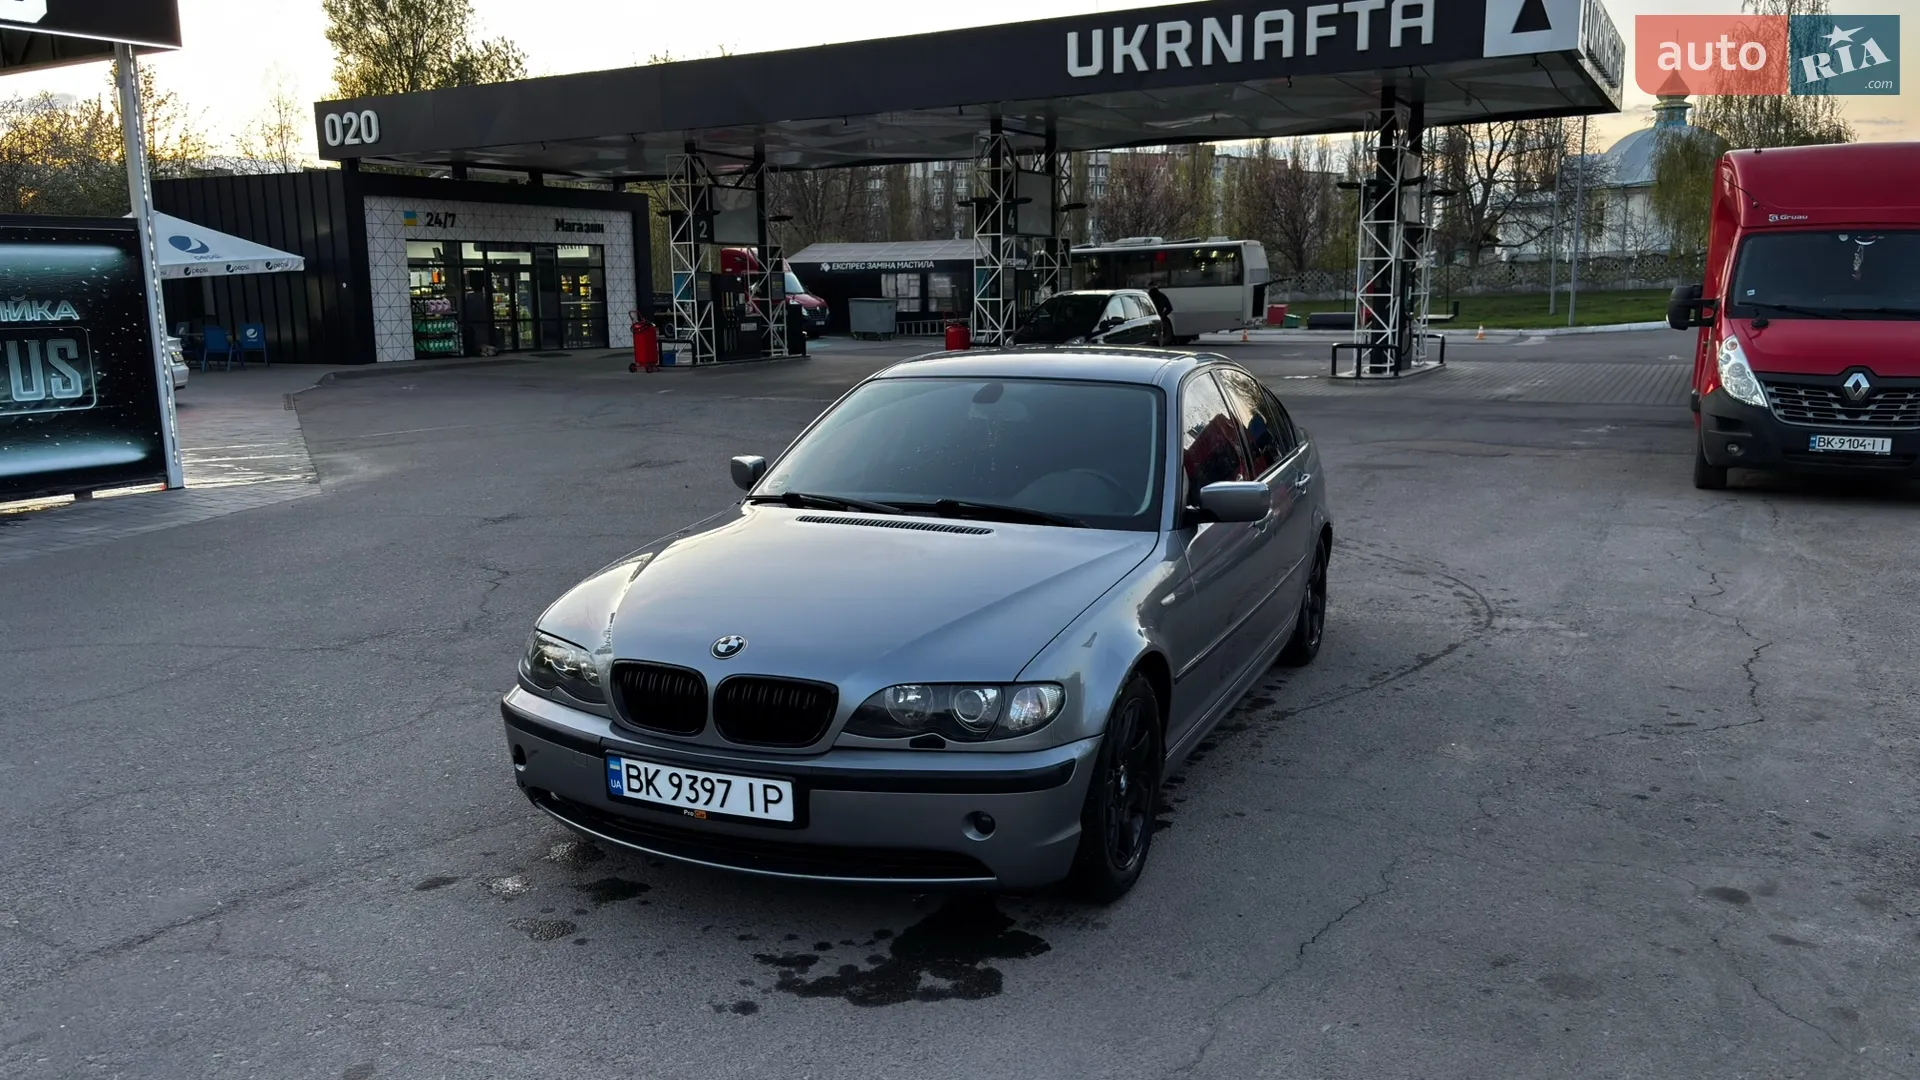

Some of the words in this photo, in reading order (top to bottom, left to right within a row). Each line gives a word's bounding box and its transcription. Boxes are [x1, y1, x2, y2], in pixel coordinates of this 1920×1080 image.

[1066, 0, 1435, 78] UKRNAFTA
[324, 109, 380, 147] 020
[425, 211, 456, 229] 24/7
[555, 218, 605, 234] Магазин
[1007, 208, 1015, 229] 4
[699, 219, 708, 239] 2
[191, 266, 209, 275] pepsi
[233, 263, 250, 272] pepsi
[832, 262, 865, 271] ЕКСПРЕС
[867, 262, 896, 270] ЗАМІНА
[897, 260, 935, 269] МАСТИЛА
[610, 779, 622, 789] UA
[625, 764, 662, 799] BK
[668, 772, 732, 809] 9397
[748, 782, 783, 814] IP
